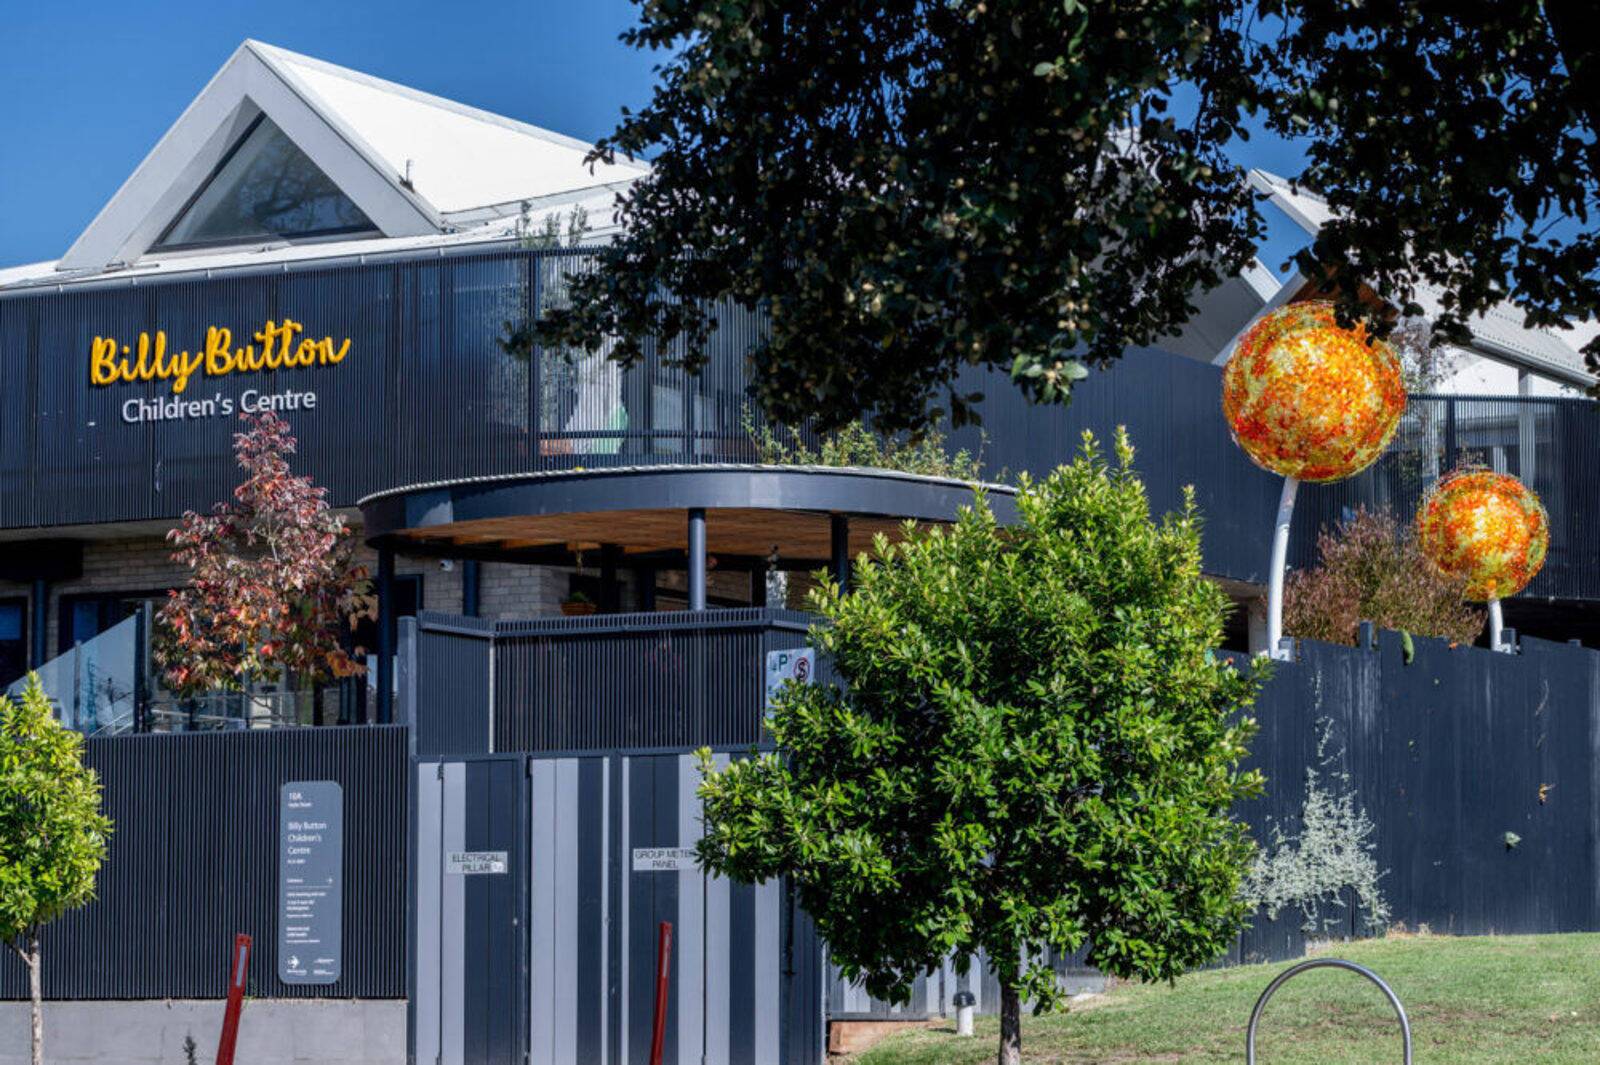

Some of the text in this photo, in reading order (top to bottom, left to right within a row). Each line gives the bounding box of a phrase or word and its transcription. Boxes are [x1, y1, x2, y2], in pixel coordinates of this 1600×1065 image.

[91, 319, 351, 394] Billy Button
[122, 390, 316, 423] Children's Centre
[303, 821, 328, 831] Button
[287, 846, 311, 855] Centre
[635, 850, 665, 860] GROUP
[452, 853, 500, 863] ELECTRICAL
[652, 860, 679, 869] PANEL
